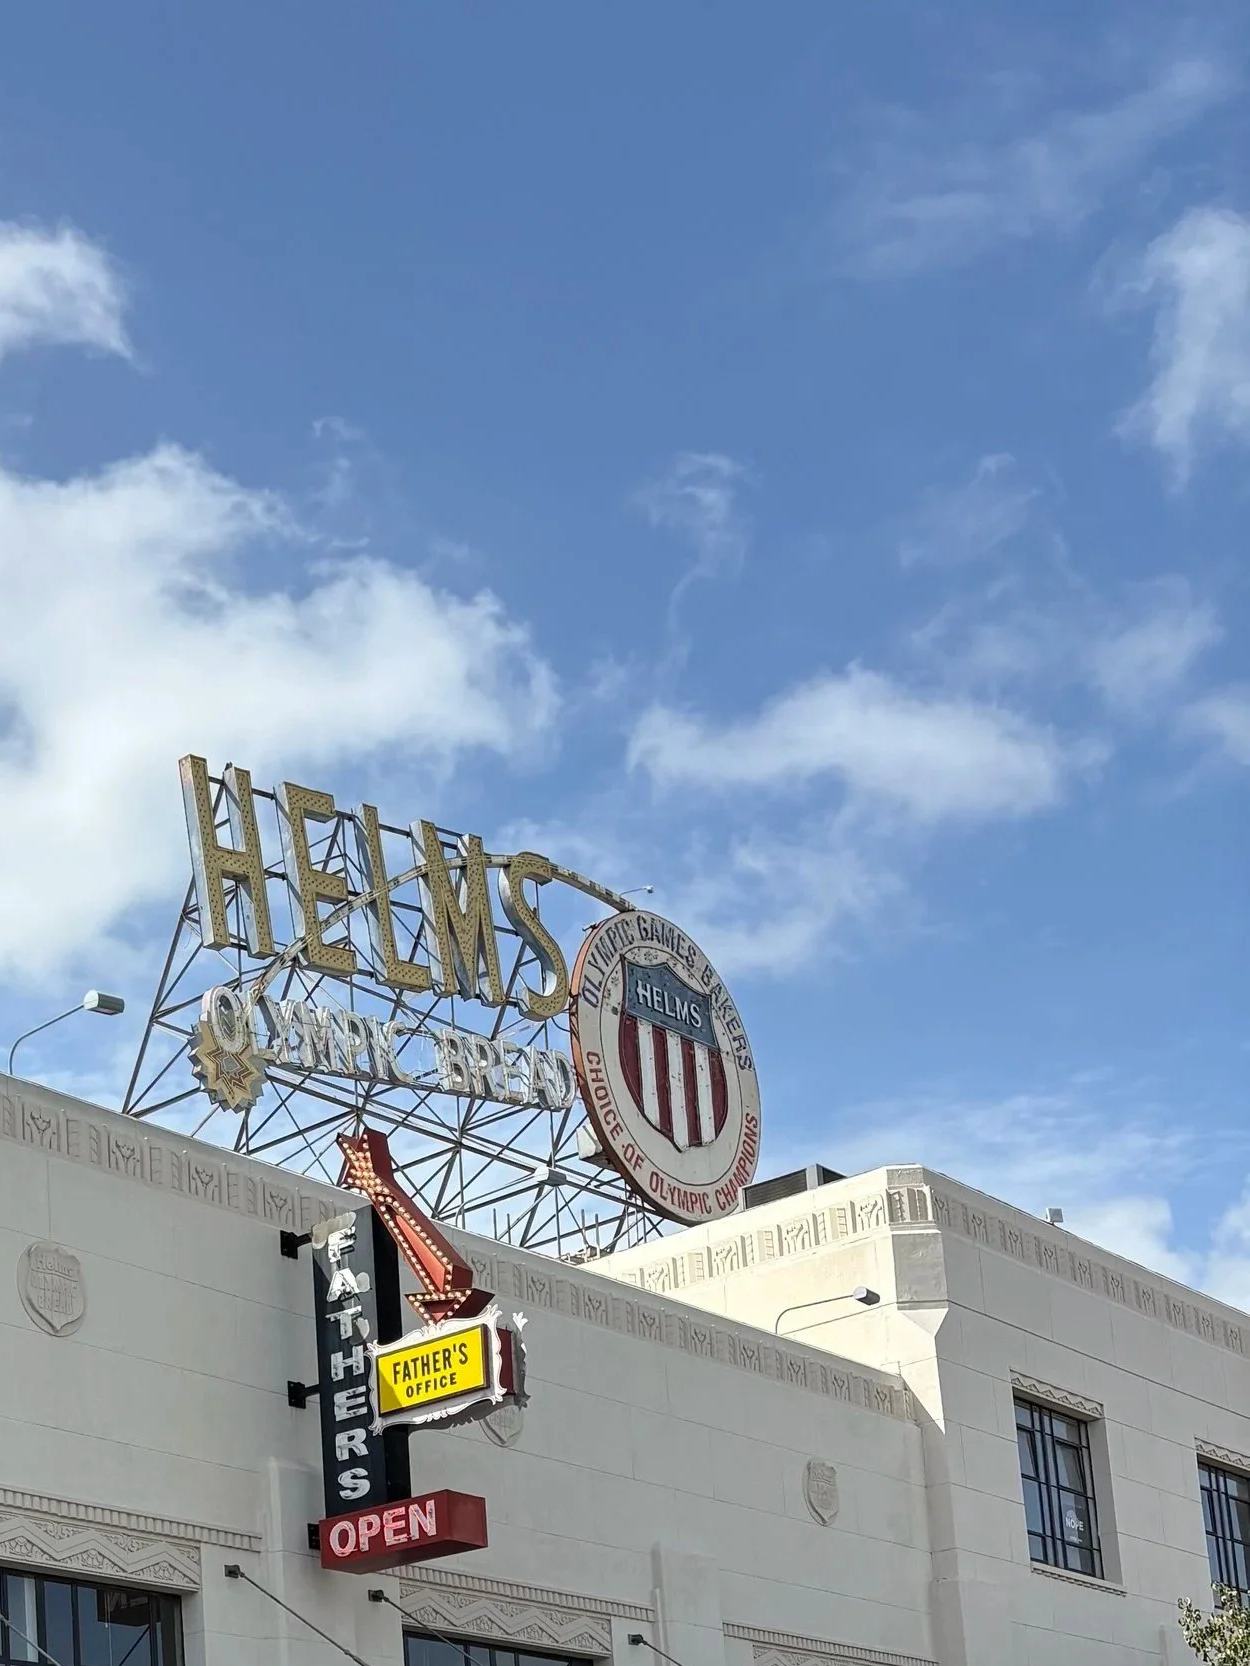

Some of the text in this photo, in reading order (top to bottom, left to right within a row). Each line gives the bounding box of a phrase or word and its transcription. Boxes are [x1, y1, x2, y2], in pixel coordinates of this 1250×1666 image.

[179, 754, 569, 1021] HELMS
[582, 915, 753, 1071] OLYMPIC GAMES BAKERS
[636, 980, 702, 1028] HELMS
[201, 985, 577, 1111] OLYMPIC BREAD
[586, 1051, 758, 1215] CHOICE OF OLYMPIC CHAMPIONS
[326, 1226, 370, 1500] FATHERS
[392, 1342, 469, 1385] FATHER'S
[405, 1372, 458, 1398] OFFICE
[329, 1498, 437, 1557] OPEN
[1066, 1517, 1084, 1531] NOPE
